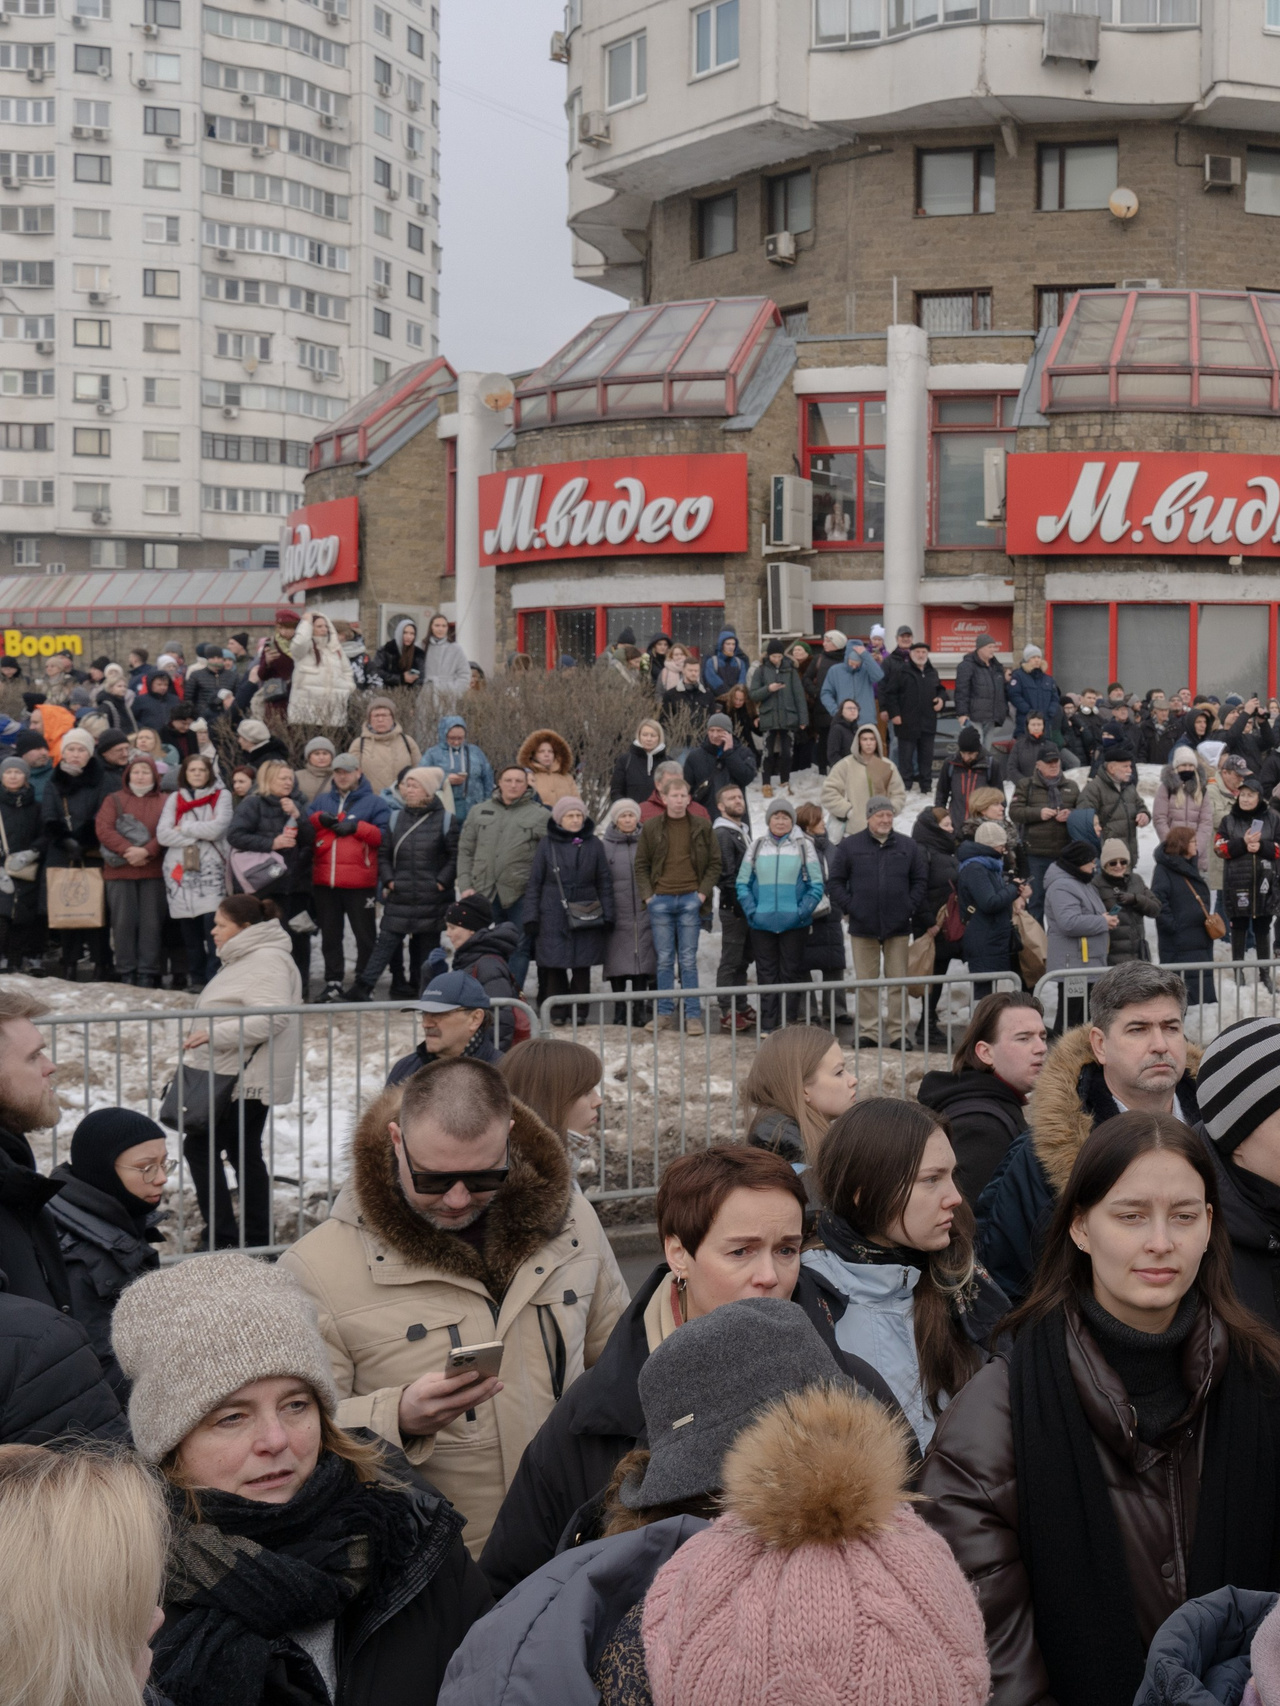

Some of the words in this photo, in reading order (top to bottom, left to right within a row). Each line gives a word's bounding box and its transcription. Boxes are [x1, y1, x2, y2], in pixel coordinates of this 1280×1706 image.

[483, 473, 714, 555] М.видео
[279, 524, 340, 584] идео
[0, 629, 83, 657] Boom
